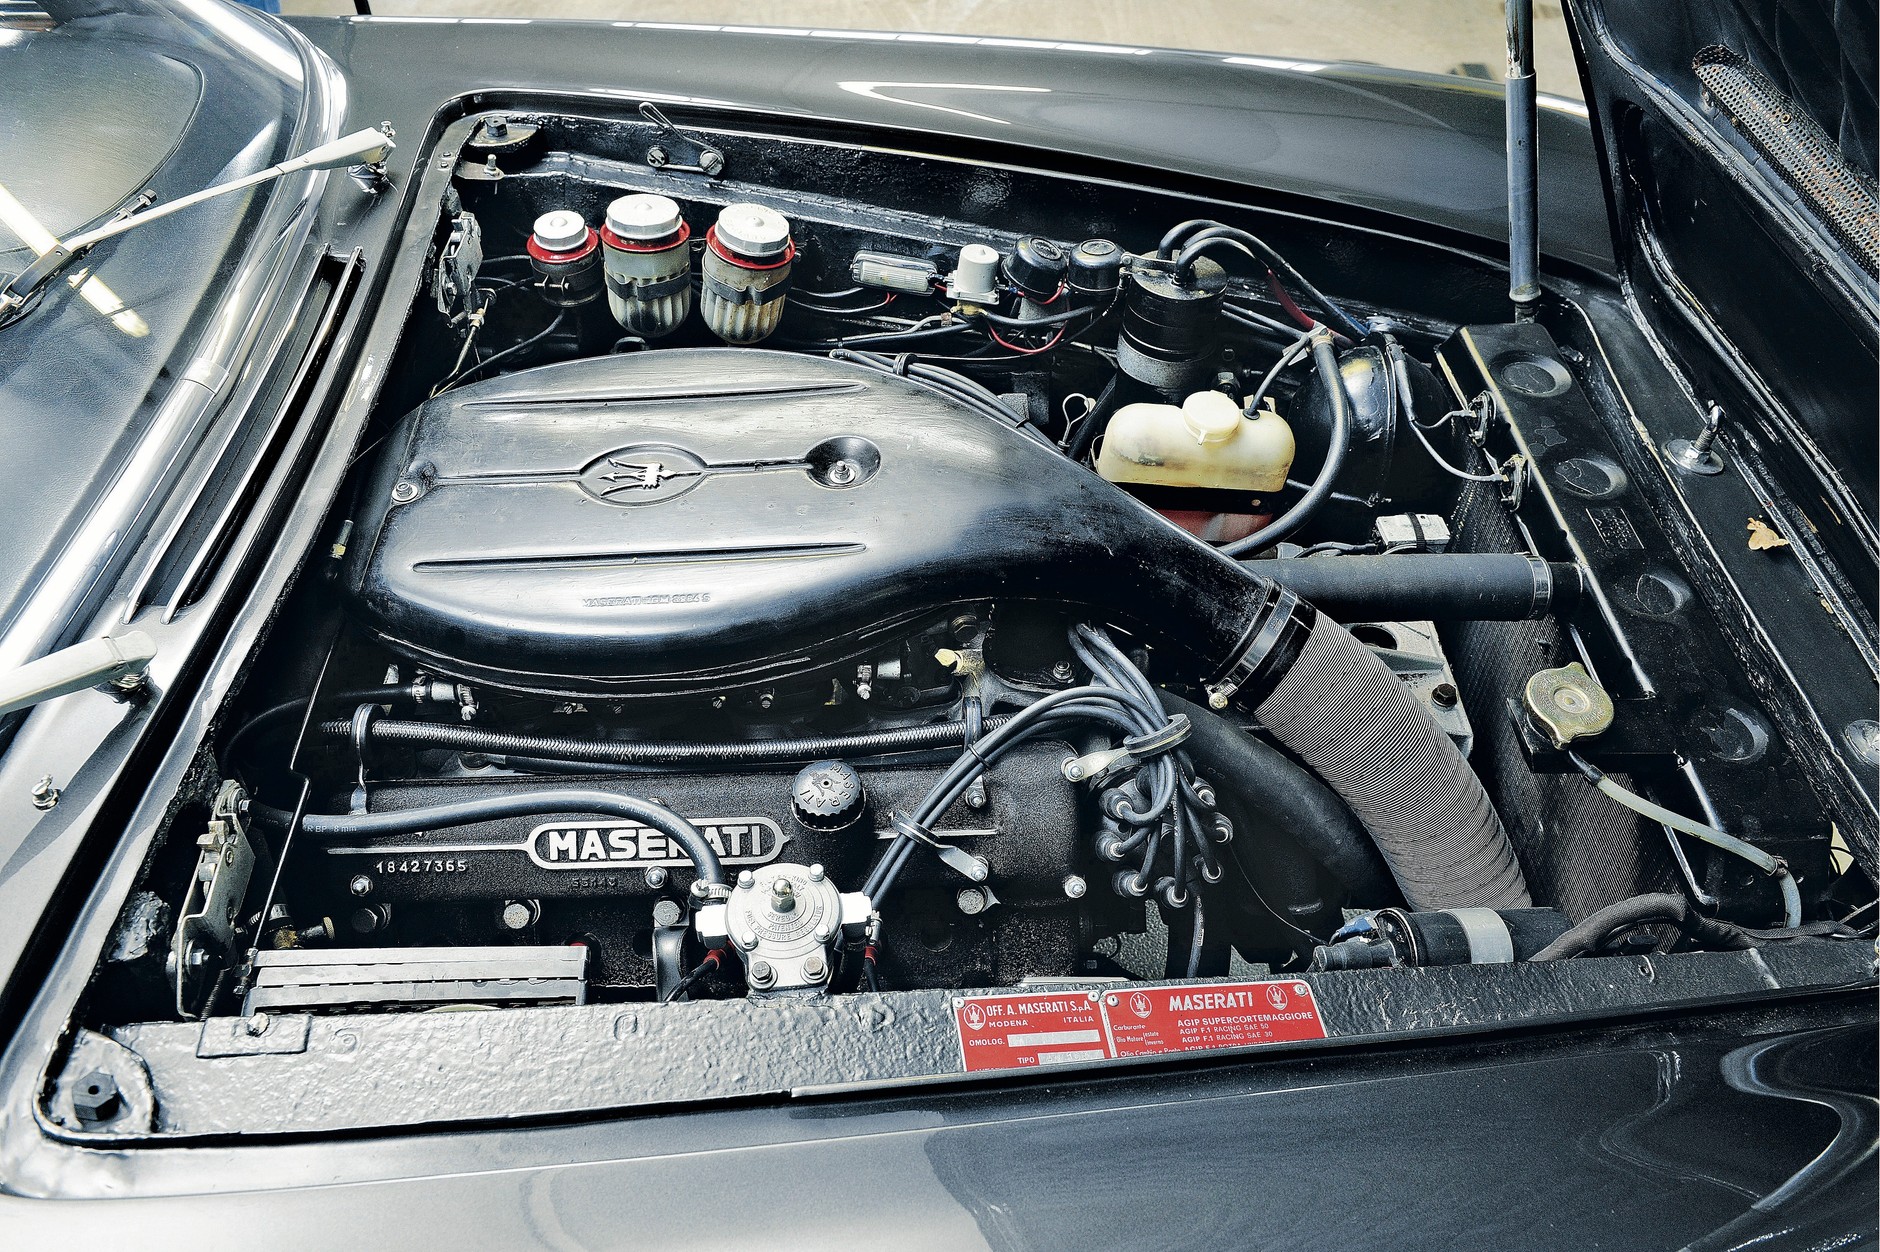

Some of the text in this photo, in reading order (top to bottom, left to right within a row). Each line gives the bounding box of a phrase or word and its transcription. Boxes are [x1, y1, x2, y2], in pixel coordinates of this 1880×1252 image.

[375, 859, 468, 874] 18427365
[1168, 991, 1254, 1012] MASERATI
[986, 1004, 1006, 1017] OFF.
[1007, 1004, 1017, 1016] A.
[1018, 1001, 1069, 1015] MASERATI
[988, 1015, 1094, 1028] MODENA ITALIA
[1177, 1011, 1314, 1027] AGIP SUPERCORTEMAGGIORE
[1179, 1027, 1198, 1035] AGIP
[1213, 1025, 1242, 1033] RACING
[968, 1037, 1005, 1047] OMOLOG.
[1182, 1035, 1200, 1043] AGIP
[1216, 1033, 1245, 1041] RACING
[1017, 1056, 1035, 1064] TIPO
